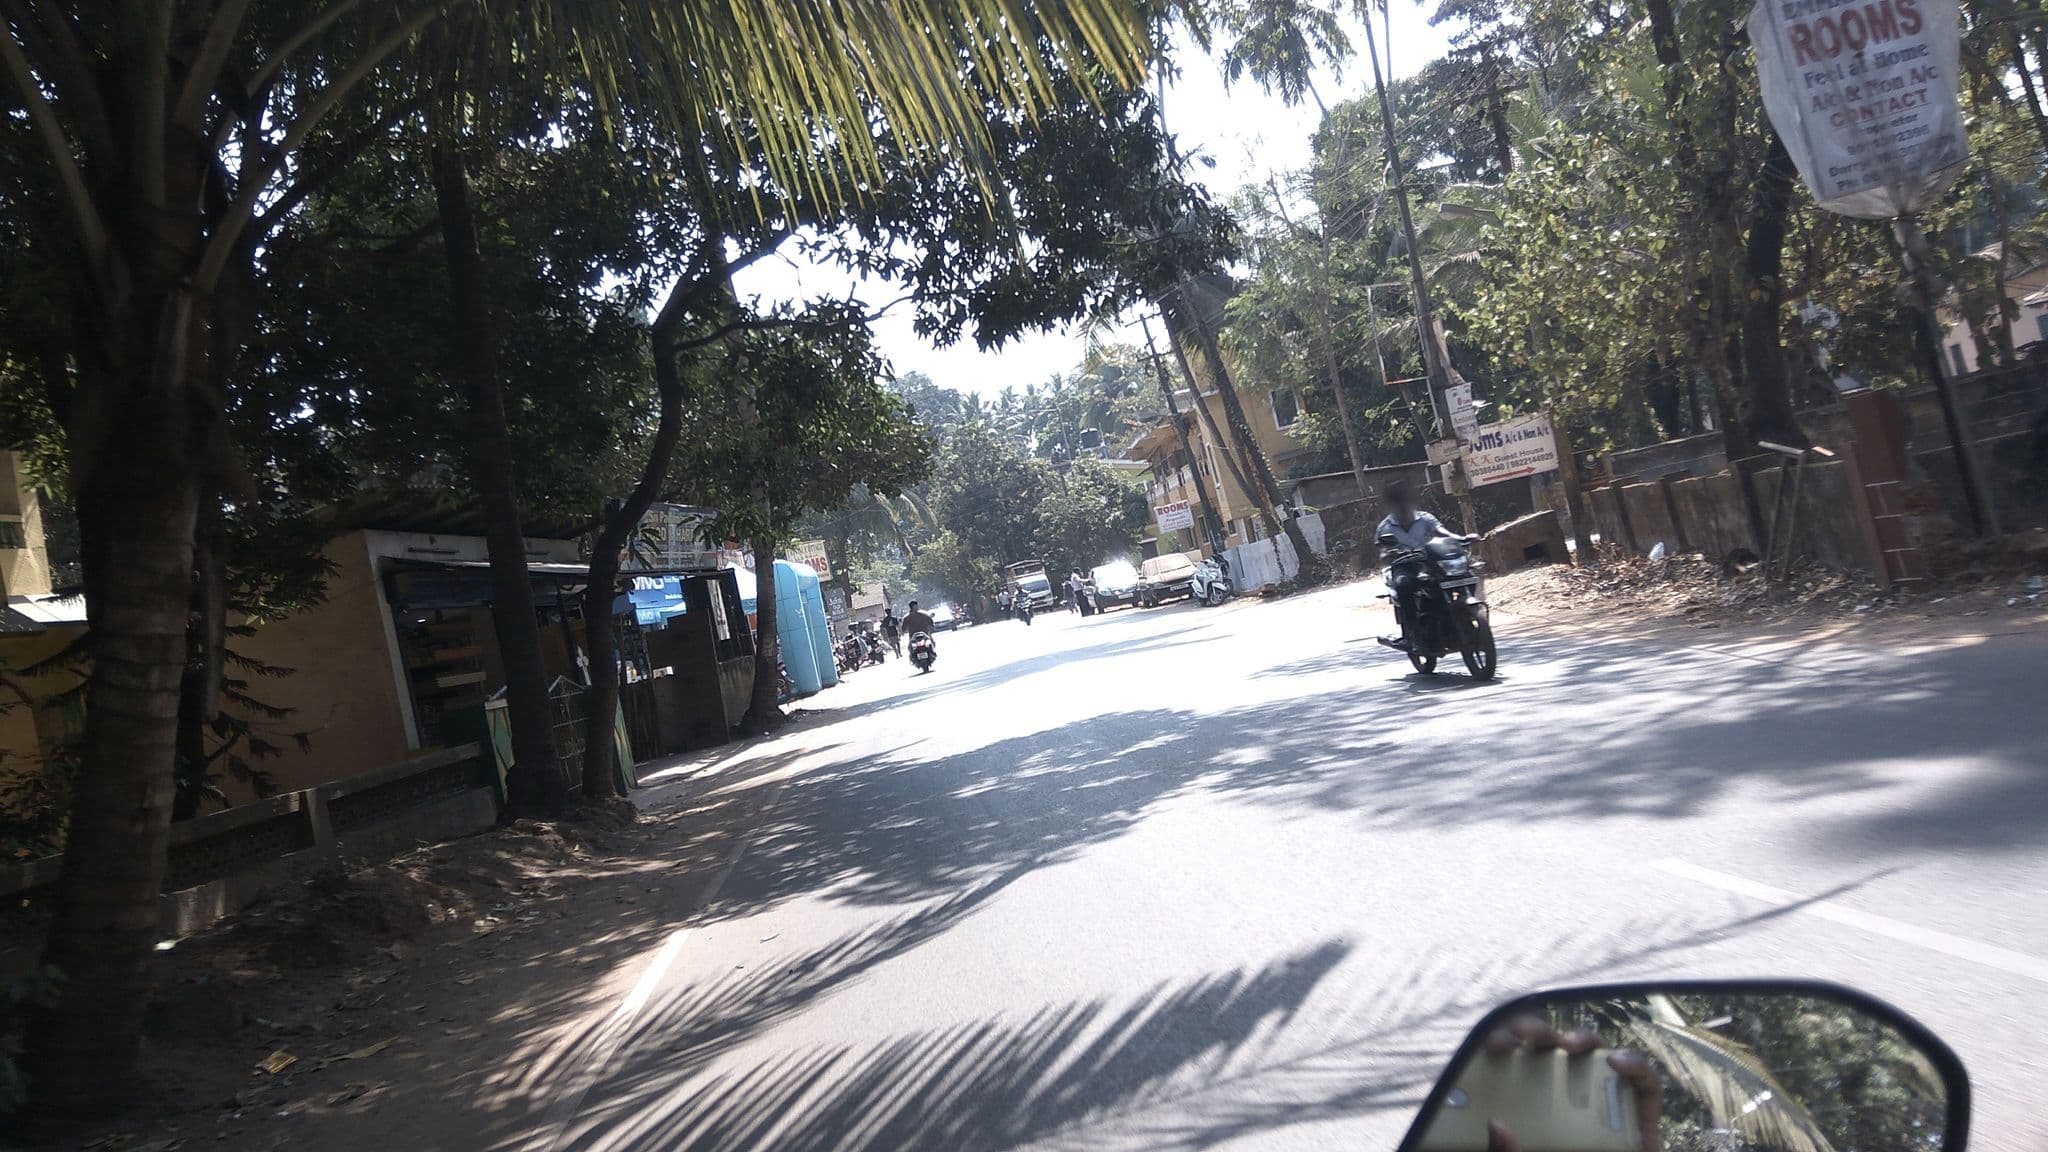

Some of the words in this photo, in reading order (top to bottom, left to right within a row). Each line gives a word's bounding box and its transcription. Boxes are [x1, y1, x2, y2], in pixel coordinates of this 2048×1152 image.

[1788, 0, 1923, 67] ROOMS
[1873, 43, 1929, 69] Home
[1830, 88, 1928, 127] CONTACT
[1494, 452, 1518, 463] Guest
[1519, 447, 1544, 457] House
[1157, 501, 1189, 515] ROOMS
